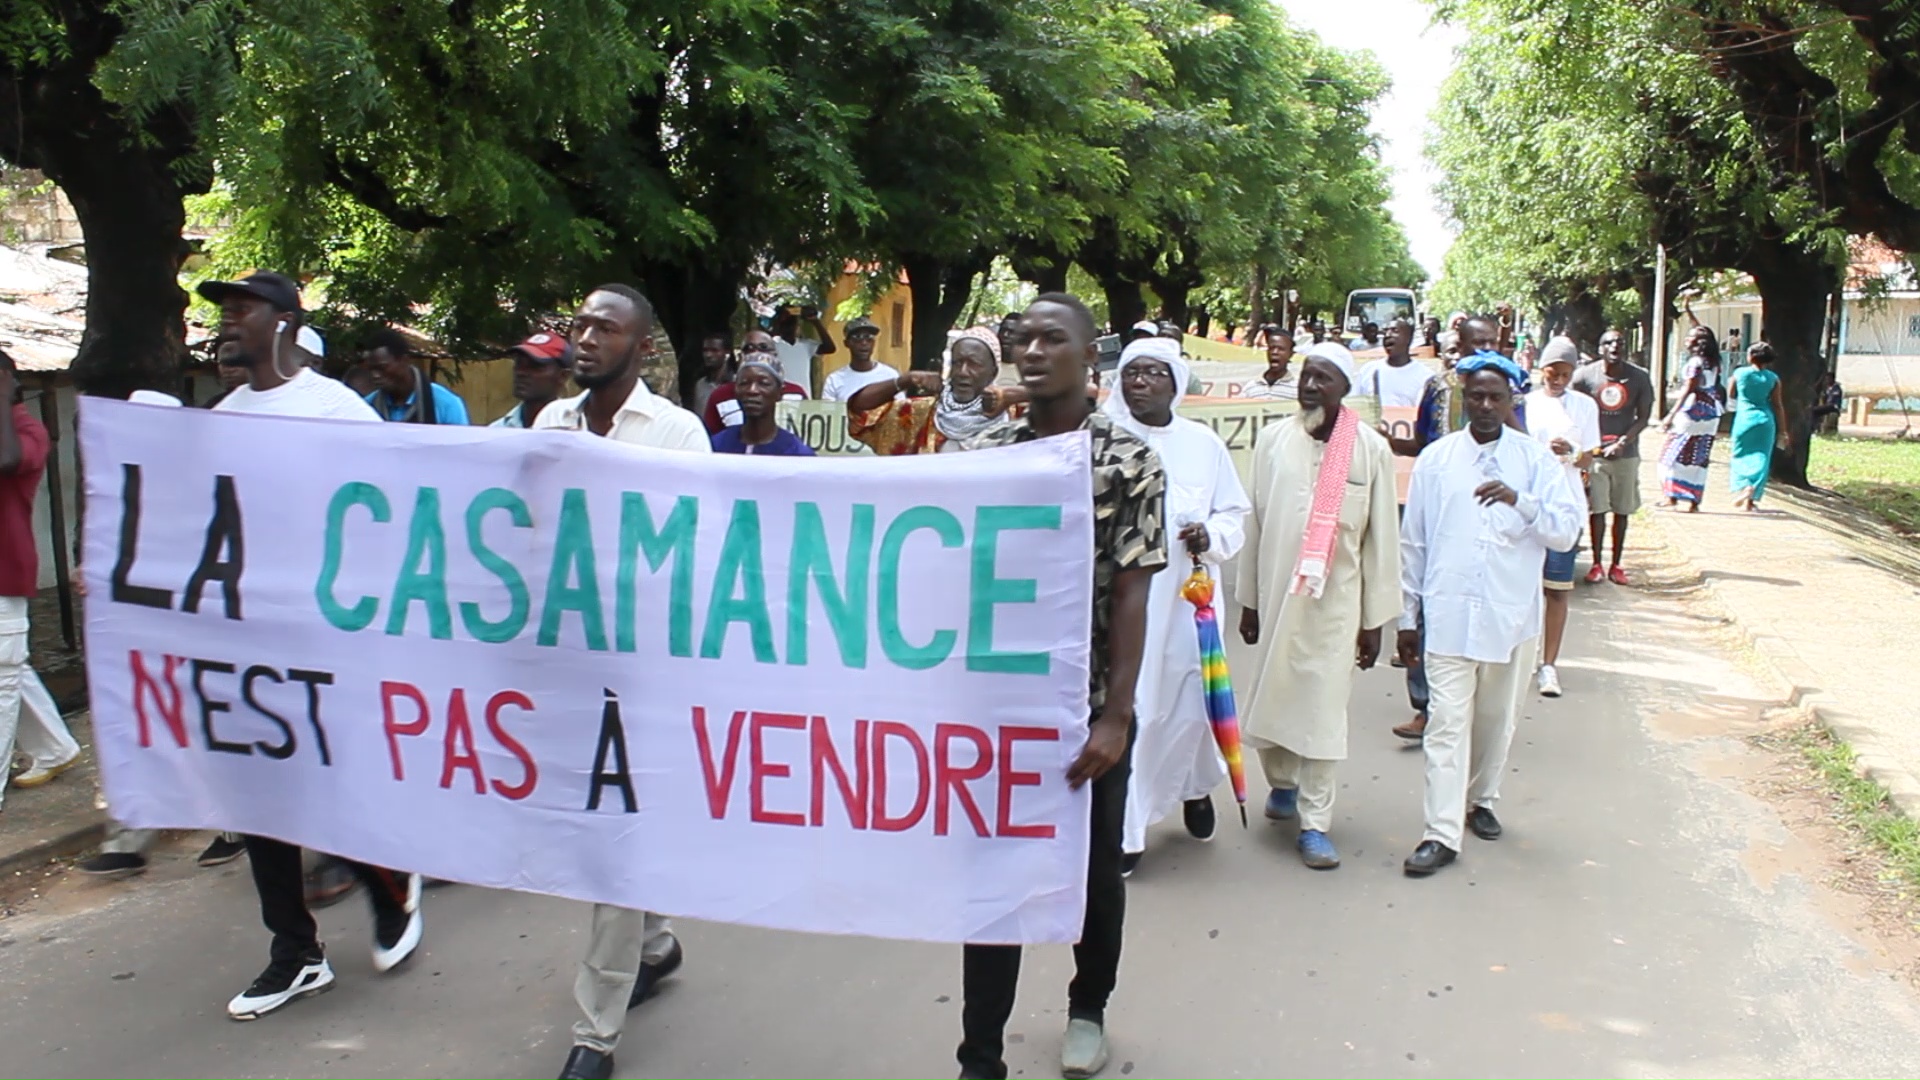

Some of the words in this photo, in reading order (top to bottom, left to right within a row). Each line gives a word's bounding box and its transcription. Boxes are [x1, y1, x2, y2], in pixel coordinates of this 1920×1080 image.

[110, 462, 245, 621] LA
[315, 481, 1062, 675] CASAMANCE
[129, 649, 333, 766] N'EST
[380, 680, 539, 800] PAS
[586, 687, 639, 814] À
[691, 705, 1060, 839] VENDRE
